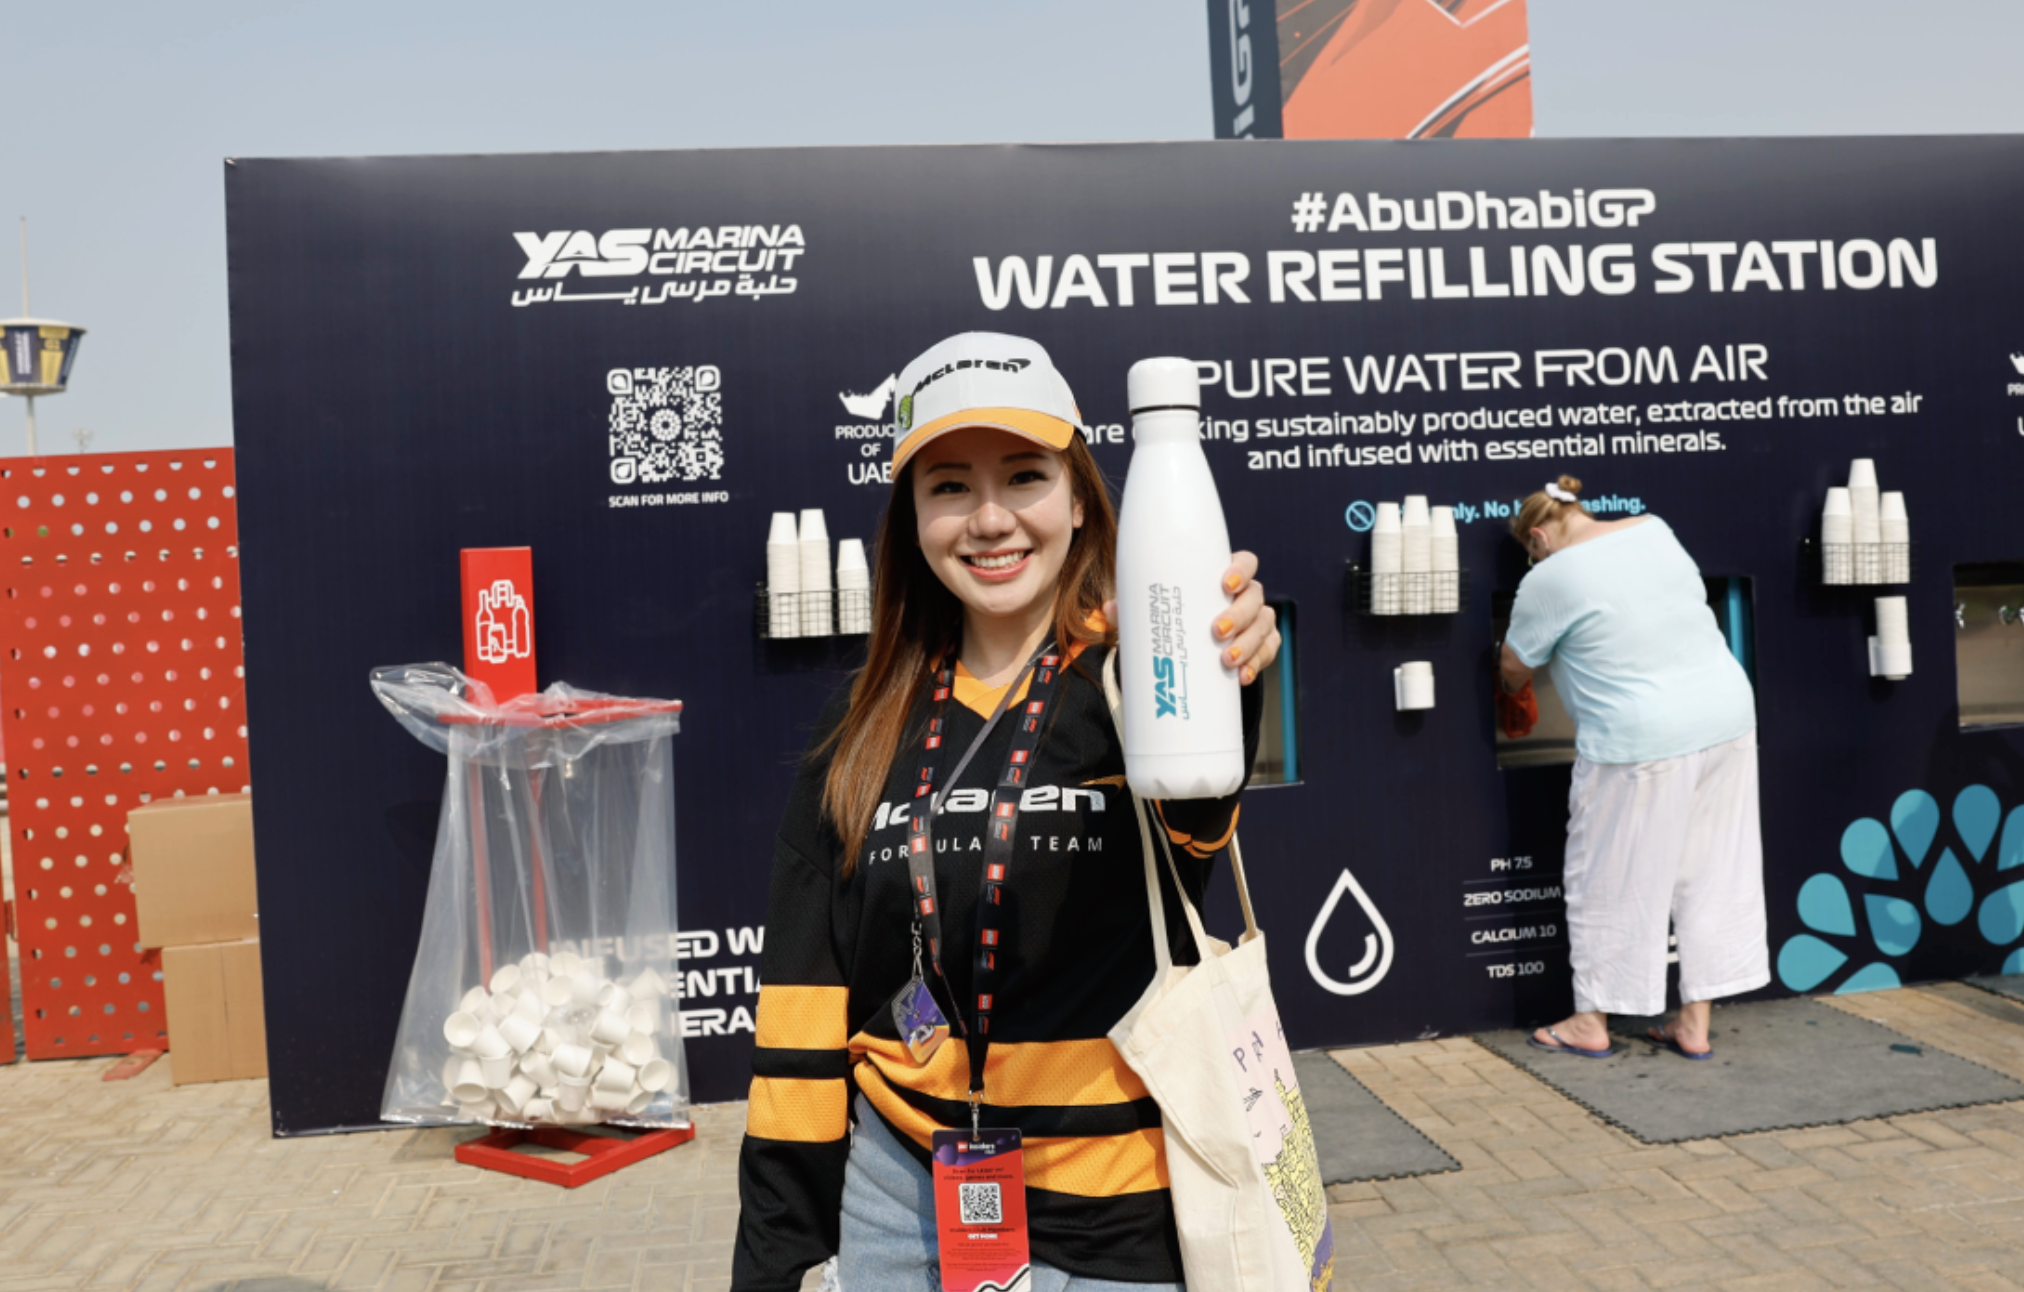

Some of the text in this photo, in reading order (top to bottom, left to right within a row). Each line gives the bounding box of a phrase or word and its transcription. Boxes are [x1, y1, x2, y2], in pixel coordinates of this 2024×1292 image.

[1291, 188, 1656, 232] #AbuDhabiGP
[512, 224, 806, 279] YAS MARINA
[647, 248, 805, 275] CIRCUIT
[735, 274, 798, 301] حلبة
[972, 237, 1939, 311] WATER REFILLING STATION
[912, 358, 1020, 397] McLaren
[1196, 343, 1768, 399] PURE WATER FROM AIR
[835, 424, 896, 439] PRODUC
[1084, 424, 1125, 444] are
[1255, 410, 1418, 438] sustainably
[1424, 403, 1552, 433] produced
[1558, 404, 1642, 428] water,
[1647, 397, 1772, 422] extracted
[1777, 395, 1838, 418] from
[1844, 393, 1886, 415] the
[1891, 390, 1923, 413] air
[861, 443, 882, 457] OF
[1247, 429, 1726, 470] and infused with essential minerals.
[848, 462, 894, 485] UAE
[608, 491, 729, 508] SCAN FOR MORE INFO
[1454, 502, 1480, 524] nly.
[1484, 501, 1509, 518] No
[1582, 494, 1646, 515] ashing.
[1160, 583, 1174, 657] CIRCUIT
[1149, 583, 1177, 719] YAS MARINA
[869, 836, 982, 865] FORULA
[1030, 835, 1103, 852] TEAM
[1491, 858, 1511, 871] PH
[1463, 886, 1561, 907] ZERO SODIUM
[1471, 924, 1557, 944] CALCIUM 10
[1486, 961, 1544, 979] TDS 100
